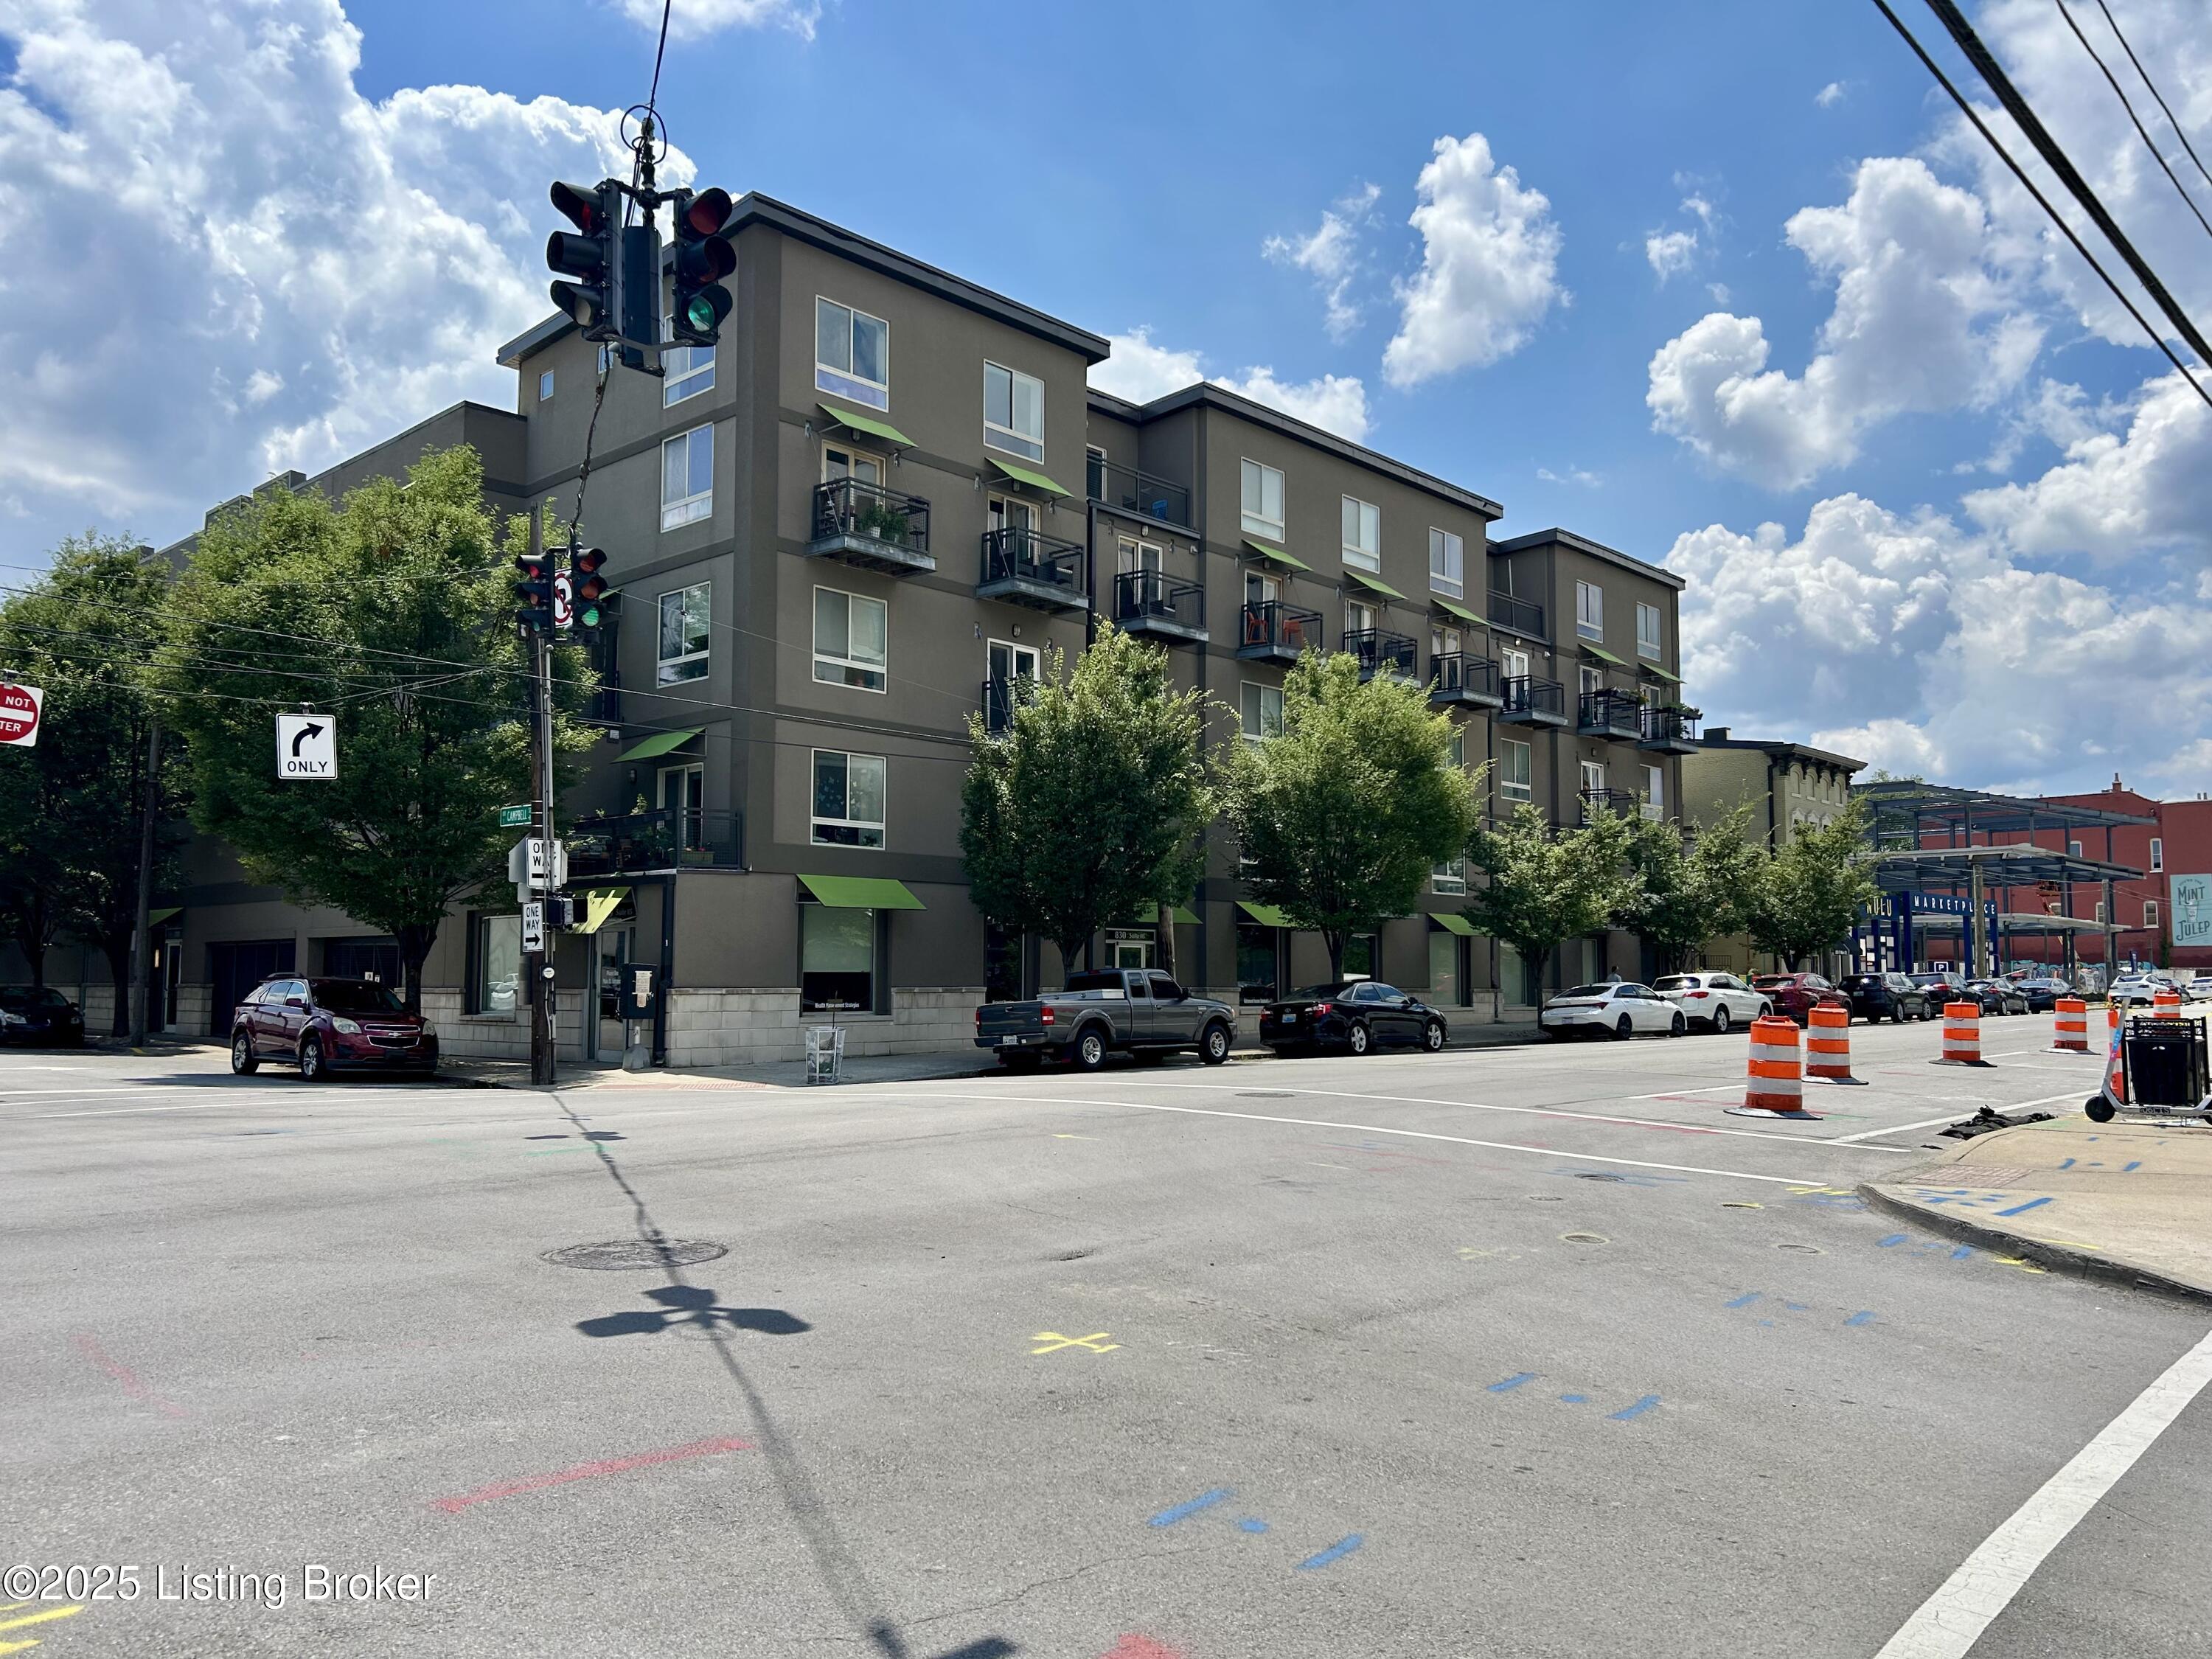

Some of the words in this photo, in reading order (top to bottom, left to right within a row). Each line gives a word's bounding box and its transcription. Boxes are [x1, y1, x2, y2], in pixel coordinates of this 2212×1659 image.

[5, 696, 31, 708] NOT
[0, 721, 21, 732] TER
[288, 761, 327, 772] ONLY
[507, 810, 527, 821] CAMPBELL
[1914, 896, 1995, 914] MARKETPLCE
[526, 906, 539, 917] ONE
[526, 919, 540, 931] WAY
[2176, 920, 2210, 941] JULEP
[1115, 931, 1126, 939] 830
